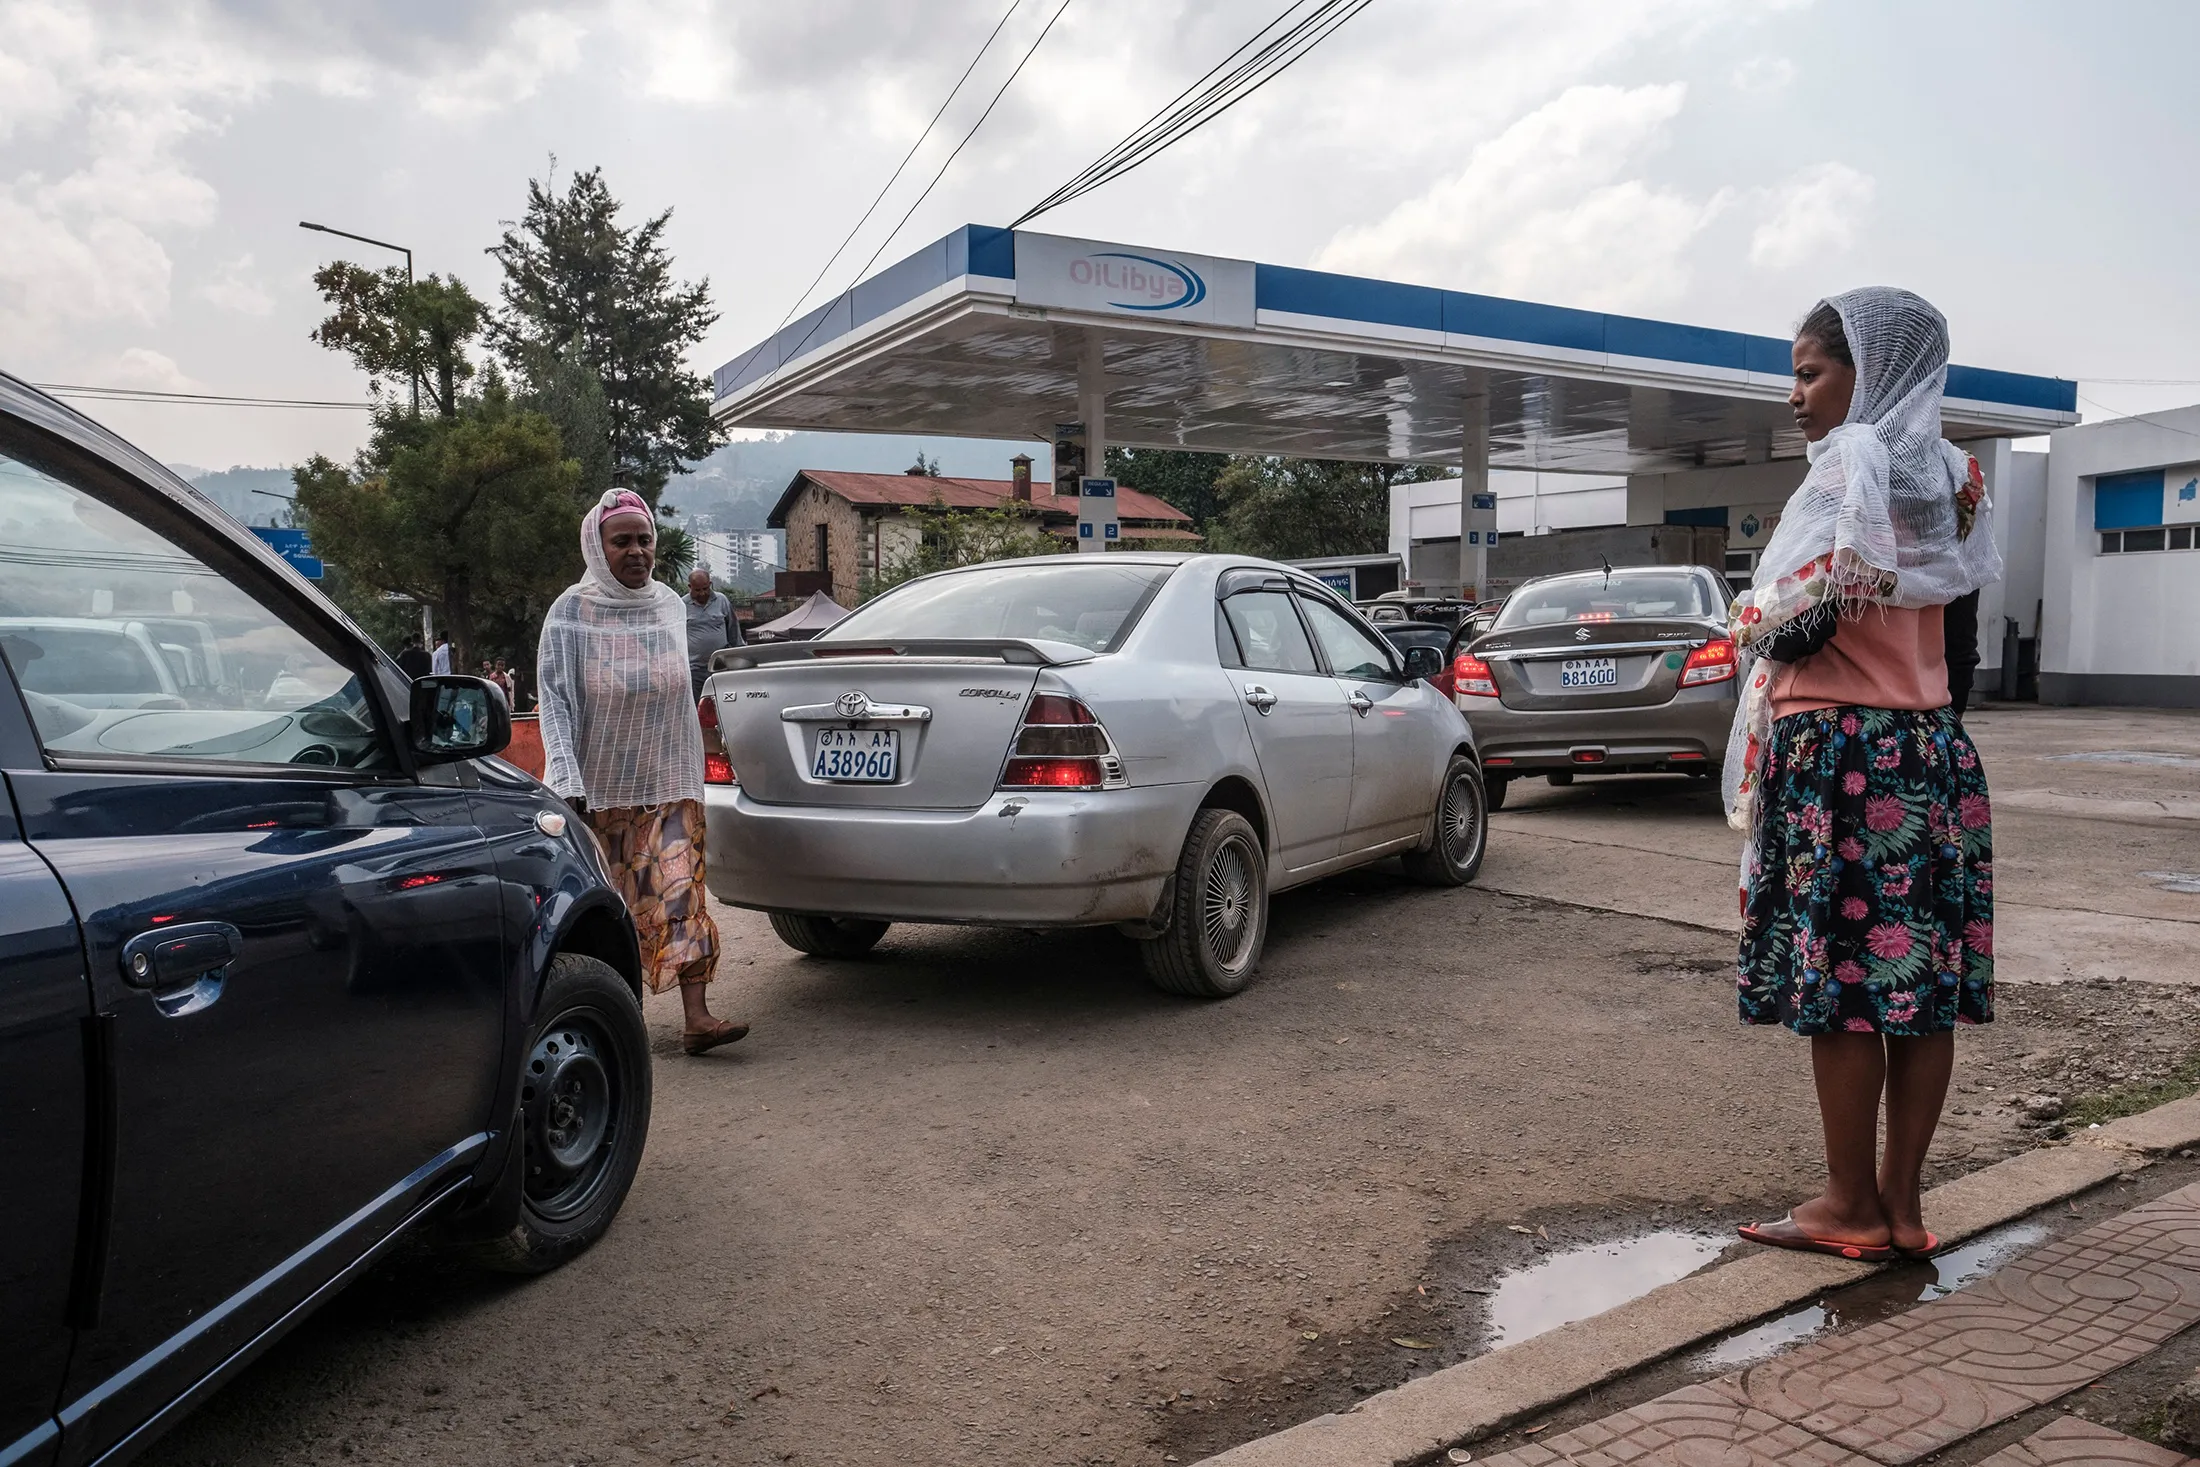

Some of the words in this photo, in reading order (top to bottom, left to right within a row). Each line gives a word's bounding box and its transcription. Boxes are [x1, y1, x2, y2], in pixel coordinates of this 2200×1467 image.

[1069, 259, 1184, 299] OiLibya
[1108, 526, 1115, 535] 2
[1472, 534, 1477, 542] 3
[1489, 534, 1494, 542] 4
[1562, 668, 1615, 686] B81600
[958, 687, 1021, 700] COROLLA
[814, 749, 892, 778] A38960
